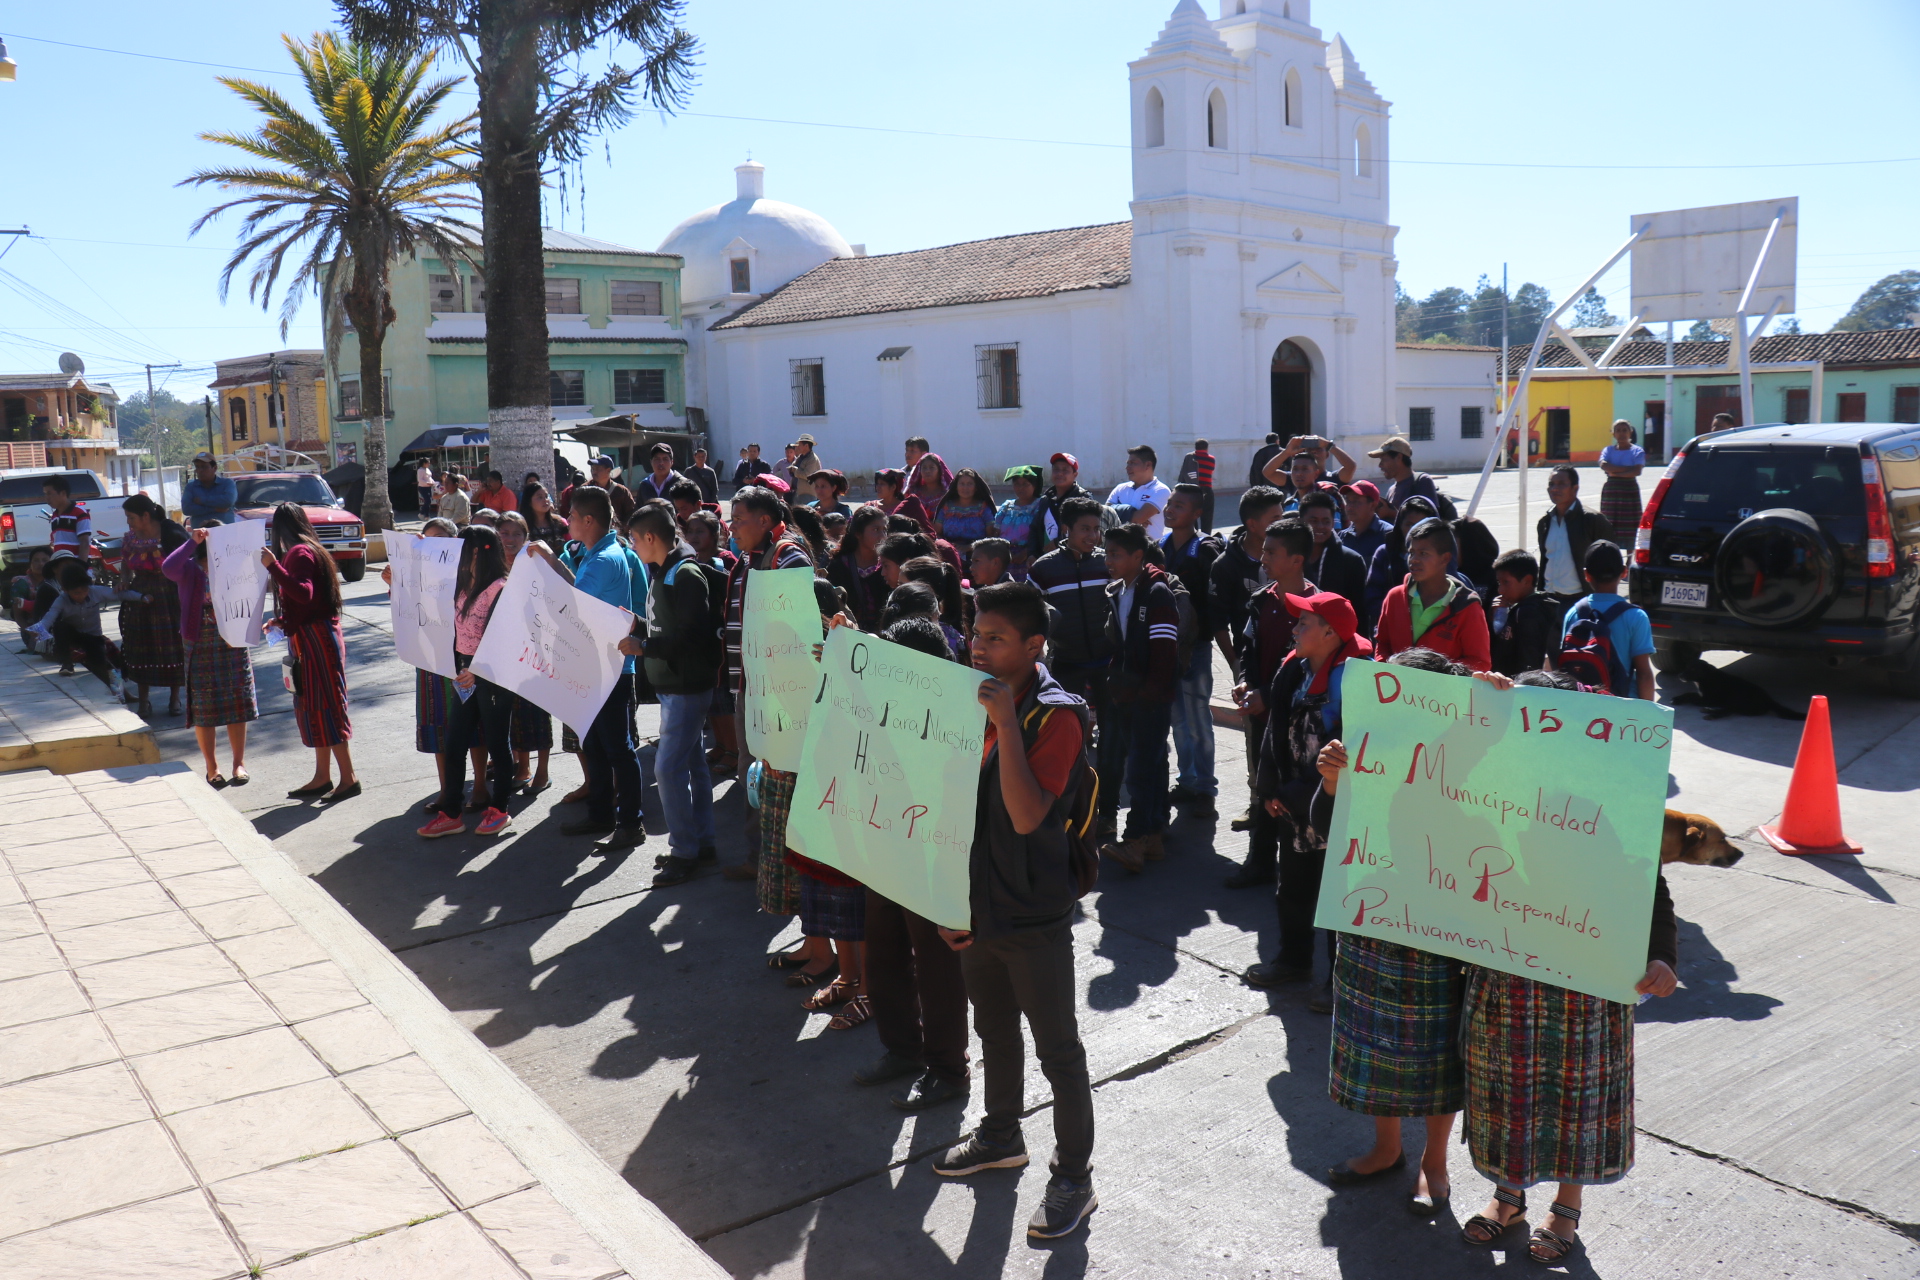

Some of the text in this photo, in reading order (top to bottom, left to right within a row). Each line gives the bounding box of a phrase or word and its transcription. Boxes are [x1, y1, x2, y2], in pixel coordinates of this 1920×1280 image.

[438, 549, 456, 564] No
[1669, 554, 1702, 563] CR-V
[1664, 586, 1706, 603] P169GJM
[558, 604, 596, 645] Alcalde
[850, 642, 943, 698] Queremos
[773, 708, 809, 733] Puert
[814, 672, 875, 723] Maestros
[878, 699, 919, 734] Para
[919, 708, 984, 756] Nuestros
[1373, 671, 1671, 750] Durante 15 años
[854, 729, 905, 786] Hijos
[1353, 731, 1604, 837] La Municipalidad
[817, 776, 969, 859] Aldea La Puerta
[1339, 826, 1602, 940] Nos ha Respondido
